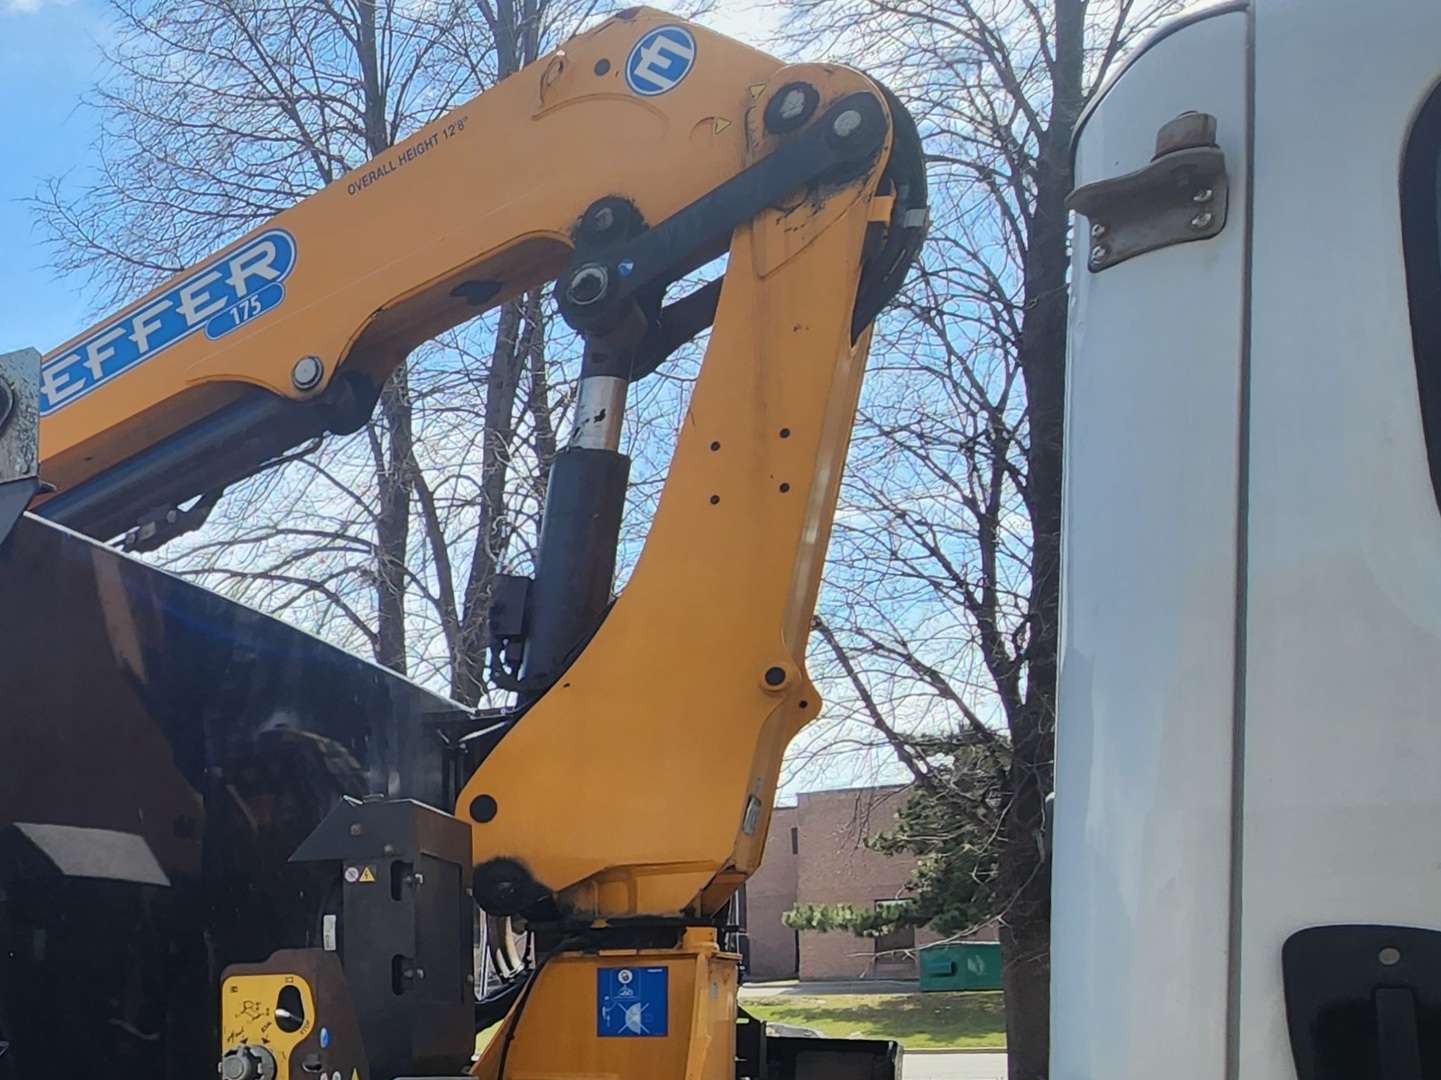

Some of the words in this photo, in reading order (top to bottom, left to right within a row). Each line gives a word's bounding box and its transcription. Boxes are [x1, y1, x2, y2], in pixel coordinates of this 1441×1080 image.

[347, 160, 397, 196] OVERALL
[398, 133, 440, 167] HEIGHT
[40, 240, 281, 406] EFFER
[229, 294, 262, 325] 175
